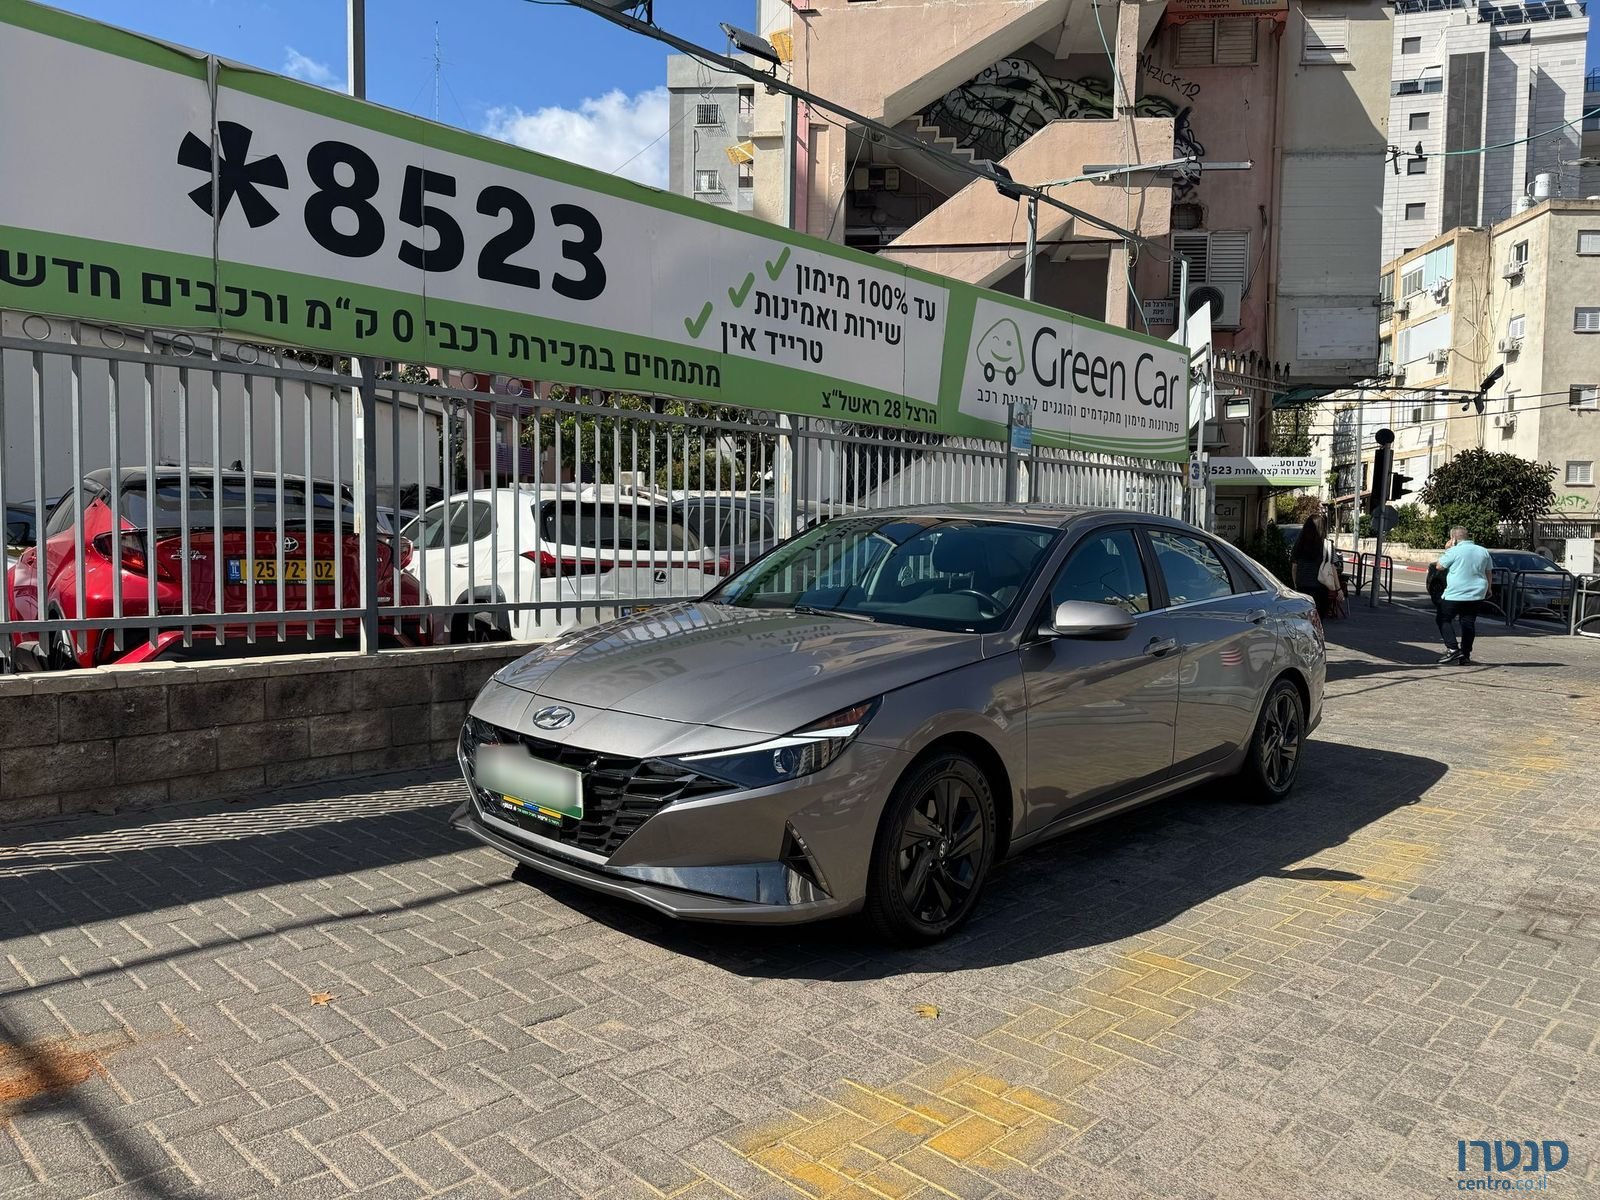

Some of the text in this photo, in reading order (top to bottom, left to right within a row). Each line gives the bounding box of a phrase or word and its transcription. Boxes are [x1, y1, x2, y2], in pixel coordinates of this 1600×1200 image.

[140, 271, 289, 325] ורכבים
[796, 263, 937, 322] עד 100% מימון
[305, 297, 379, 340] ק"מ
[392, 308, 414, 343] 0
[754, 290, 901, 346] שירות ואמינות
[424, 319, 499, 356] רכבי
[508, 332, 616, 373] במכירת
[720, 321, 823, 364] טרייד אין
[624, 350, 721, 388] מתמחים
[1032, 326, 1180, 411] Green Car
[821, 388, 938, 425] הרצל 28 ראשל"צ
[977, 388, 998, 404] רכב
[1041, 400, 1078, 418] והוגנים
[1080, 406, 1122, 425] מתקדמים
[1123, 413, 1147, 430] מימון
[1148, 420, 1180, 434] פתרונות
[1208, 466, 1232, 475] 523
[1260, 468, 1278, 477] קצת
[1292, 467, 1317, 475] אצלנו
[1297, 458, 1316, 467] שלם
[1215, 503, 1238, 516] Car
